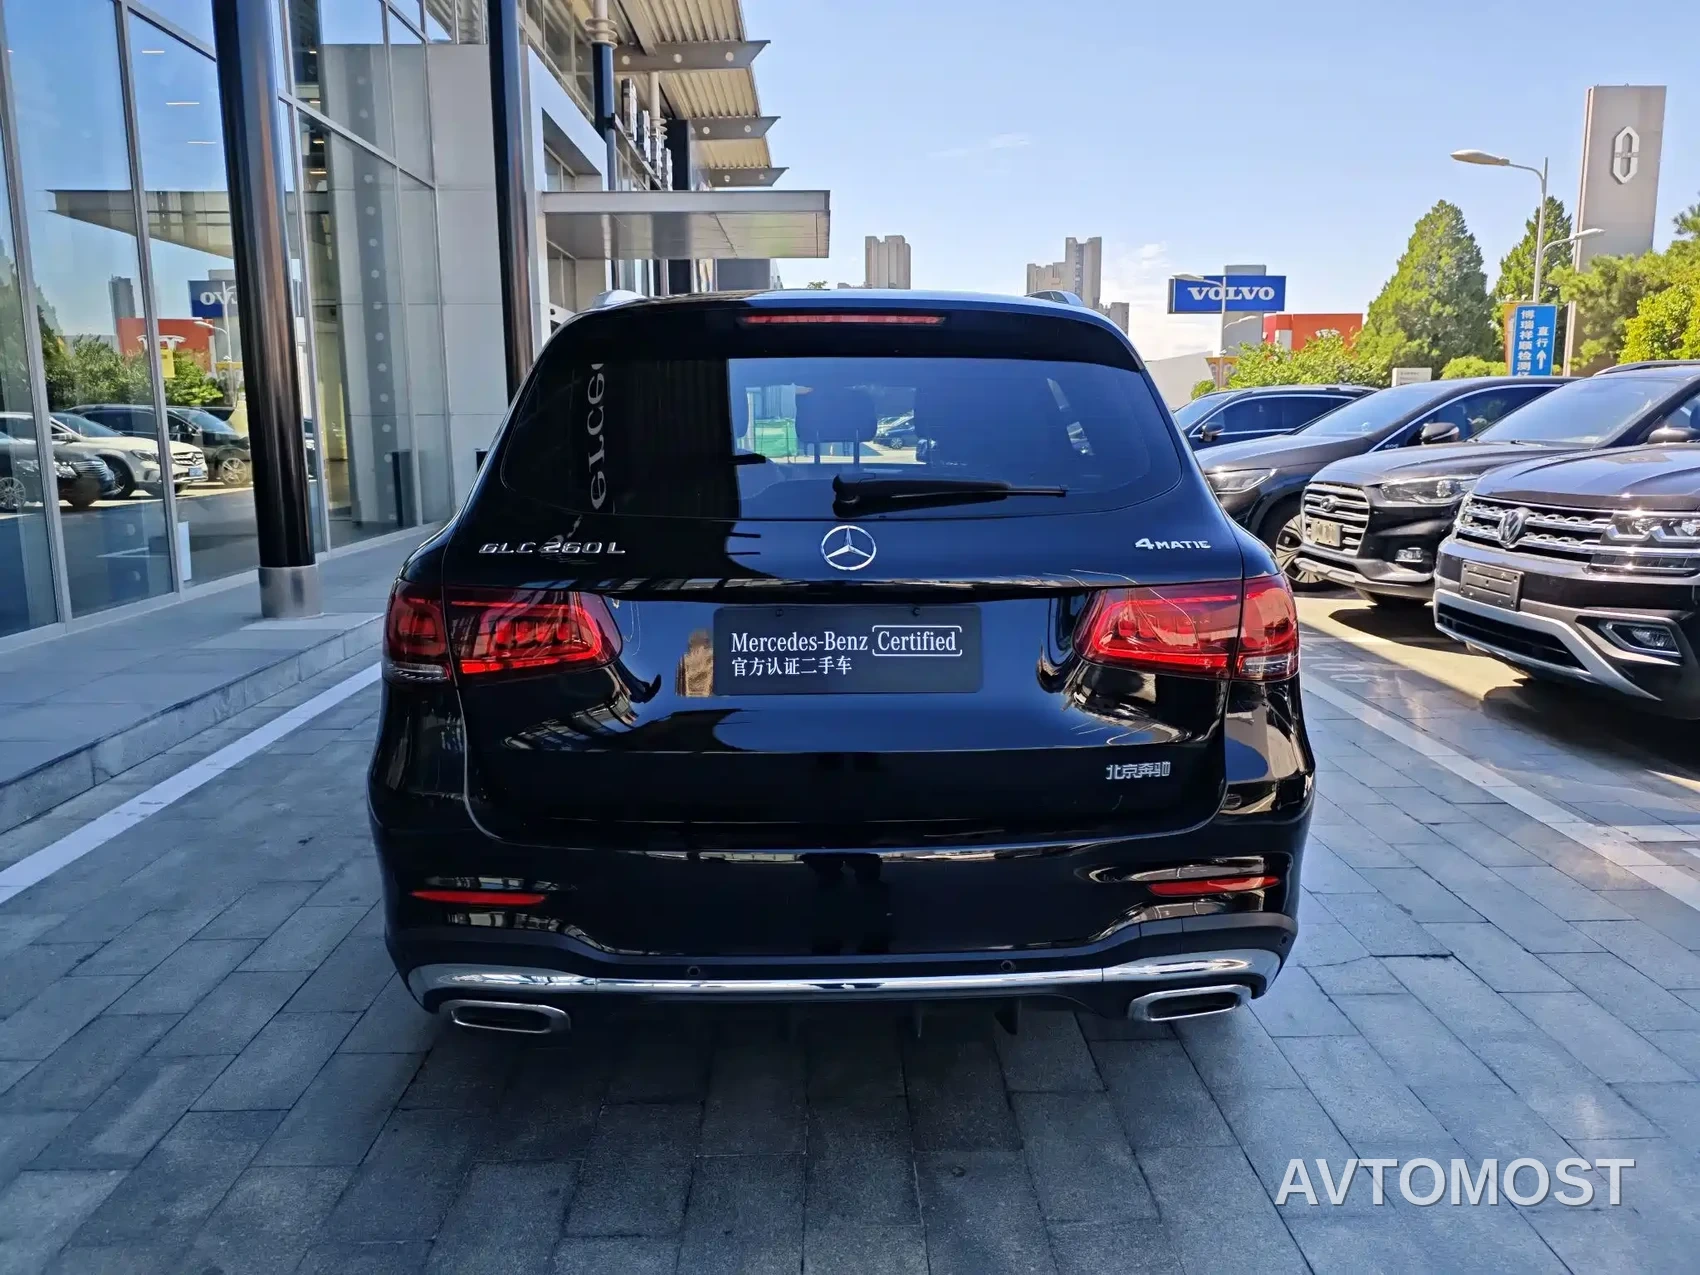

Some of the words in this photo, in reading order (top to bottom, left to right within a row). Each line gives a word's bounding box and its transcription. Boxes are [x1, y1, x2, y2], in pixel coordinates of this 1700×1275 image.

[1187, 286, 1275, 301] VOLVO
[1536, 326, 1549, 348] 直行
[478, 542, 536, 554] GLC
[540, 541, 603, 554] 260
[606, 542, 626, 554] L
[1135, 538, 1211, 550] 4MATIC
[731, 631, 868, 652] Mercedes-Benz
[877, 630, 957, 651] Certified
[731, 655, 852, 677] 官方认证二手车
[1106, 761, 1171, 780] 北京奔驰
